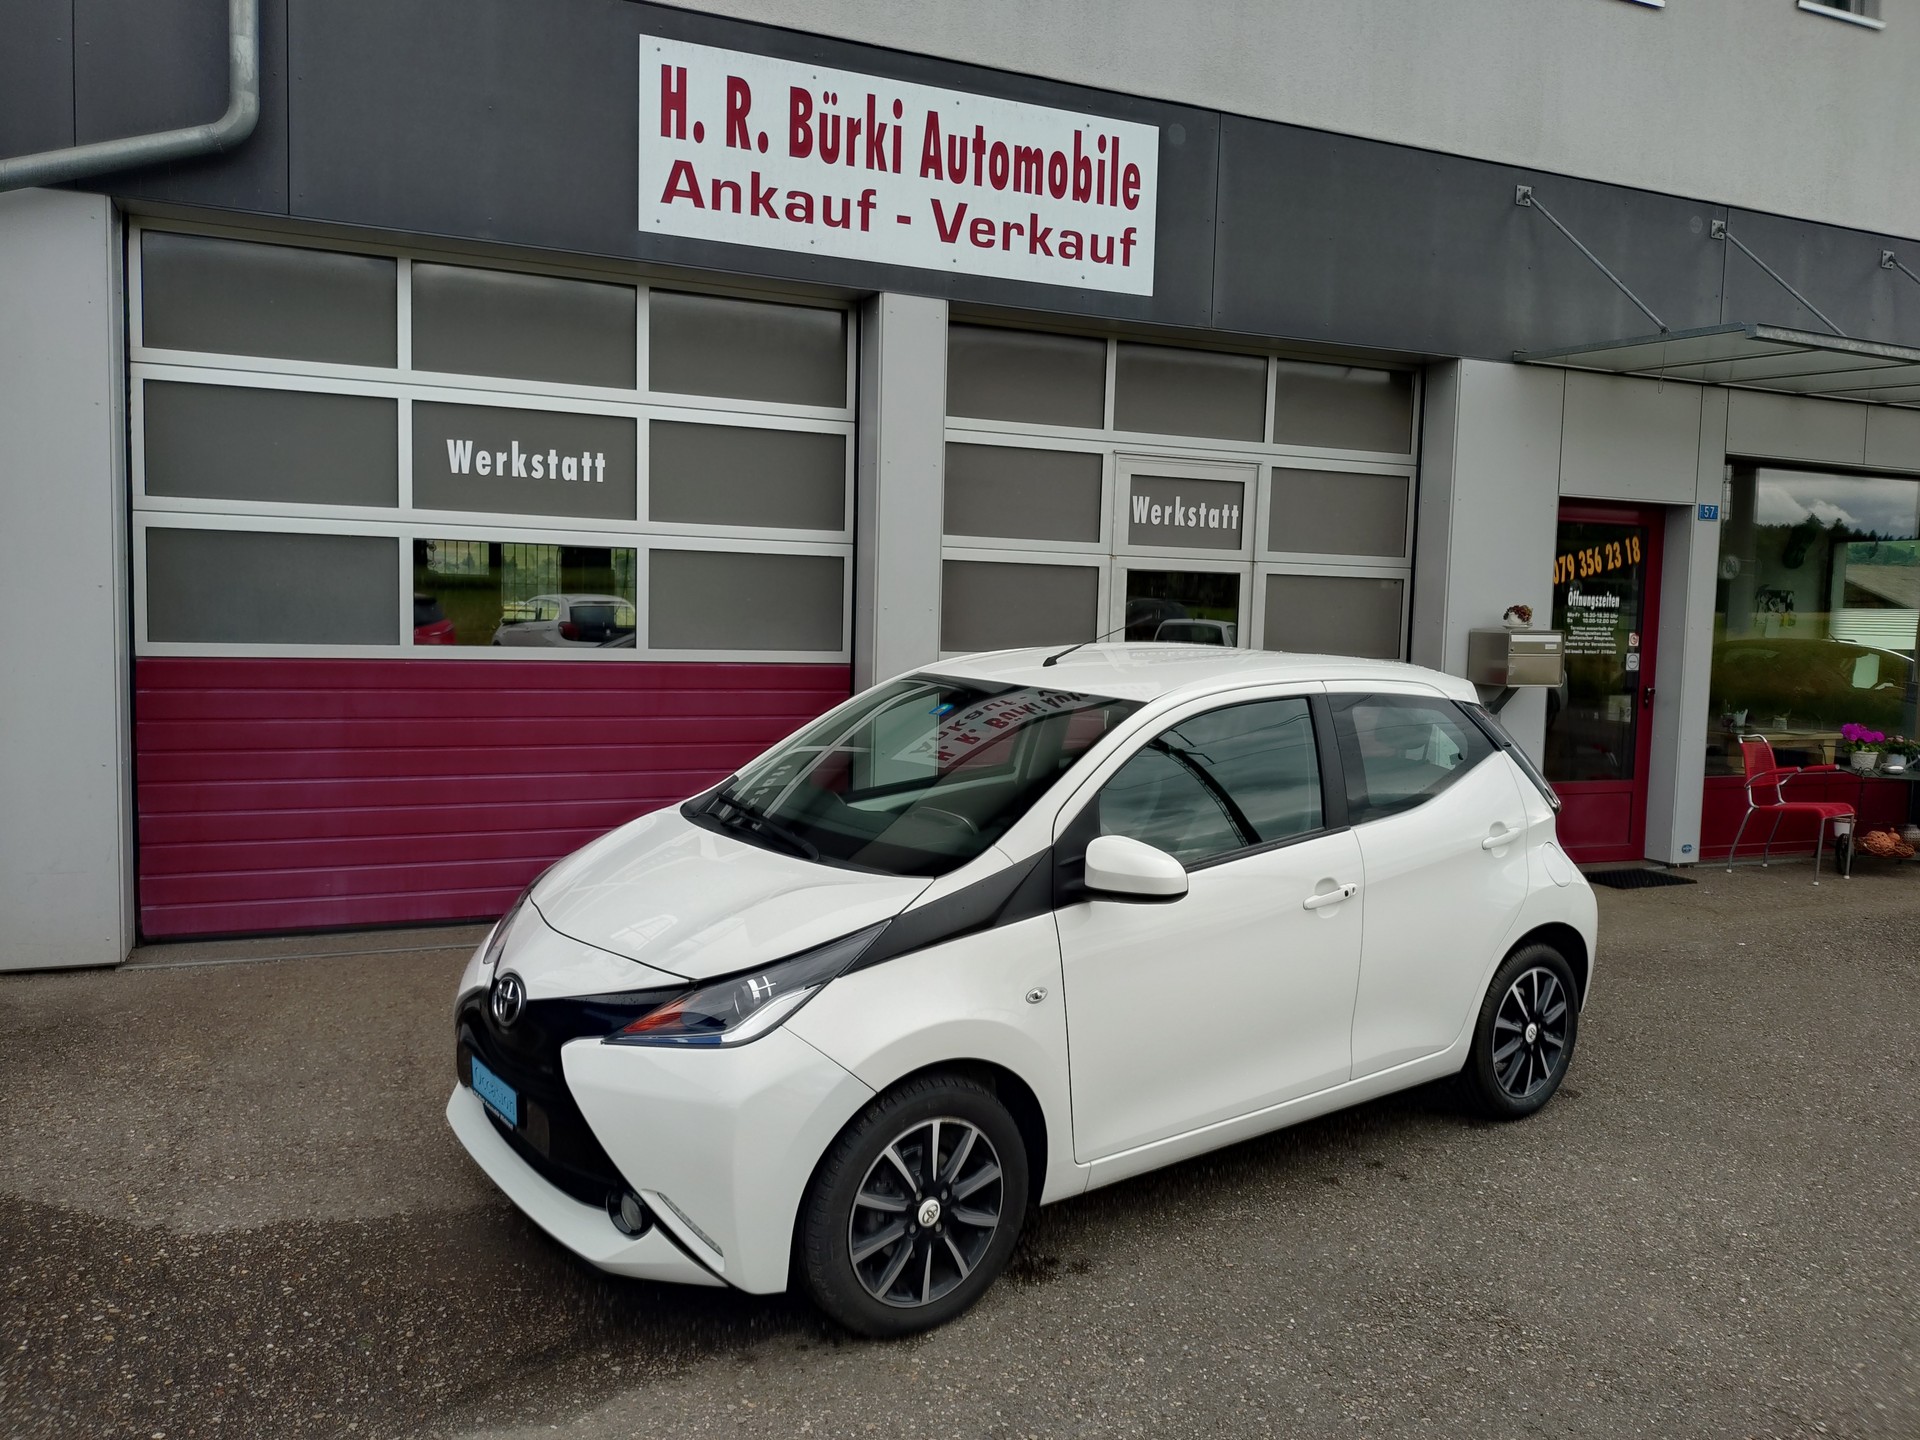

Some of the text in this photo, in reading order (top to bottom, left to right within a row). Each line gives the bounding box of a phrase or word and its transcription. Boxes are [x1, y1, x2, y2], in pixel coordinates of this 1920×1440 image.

[660, 63, 1141, 210] H. R. Bürki Automobile
[660, 160, 1137, 268] Ankauf - Verkauf
[446, 439, 606, 483] Werkstatt
[1132, 495, 1239, 530] Werkstatt
[1703, 505, 1716, 518] 57
[1578, 546, 1602, 578] 356
[1605, 541, 1622, 571] 23
[1625, 535, 1641, 565] 18
[1567, 587, 1620, 610] Öffnungszeiten
